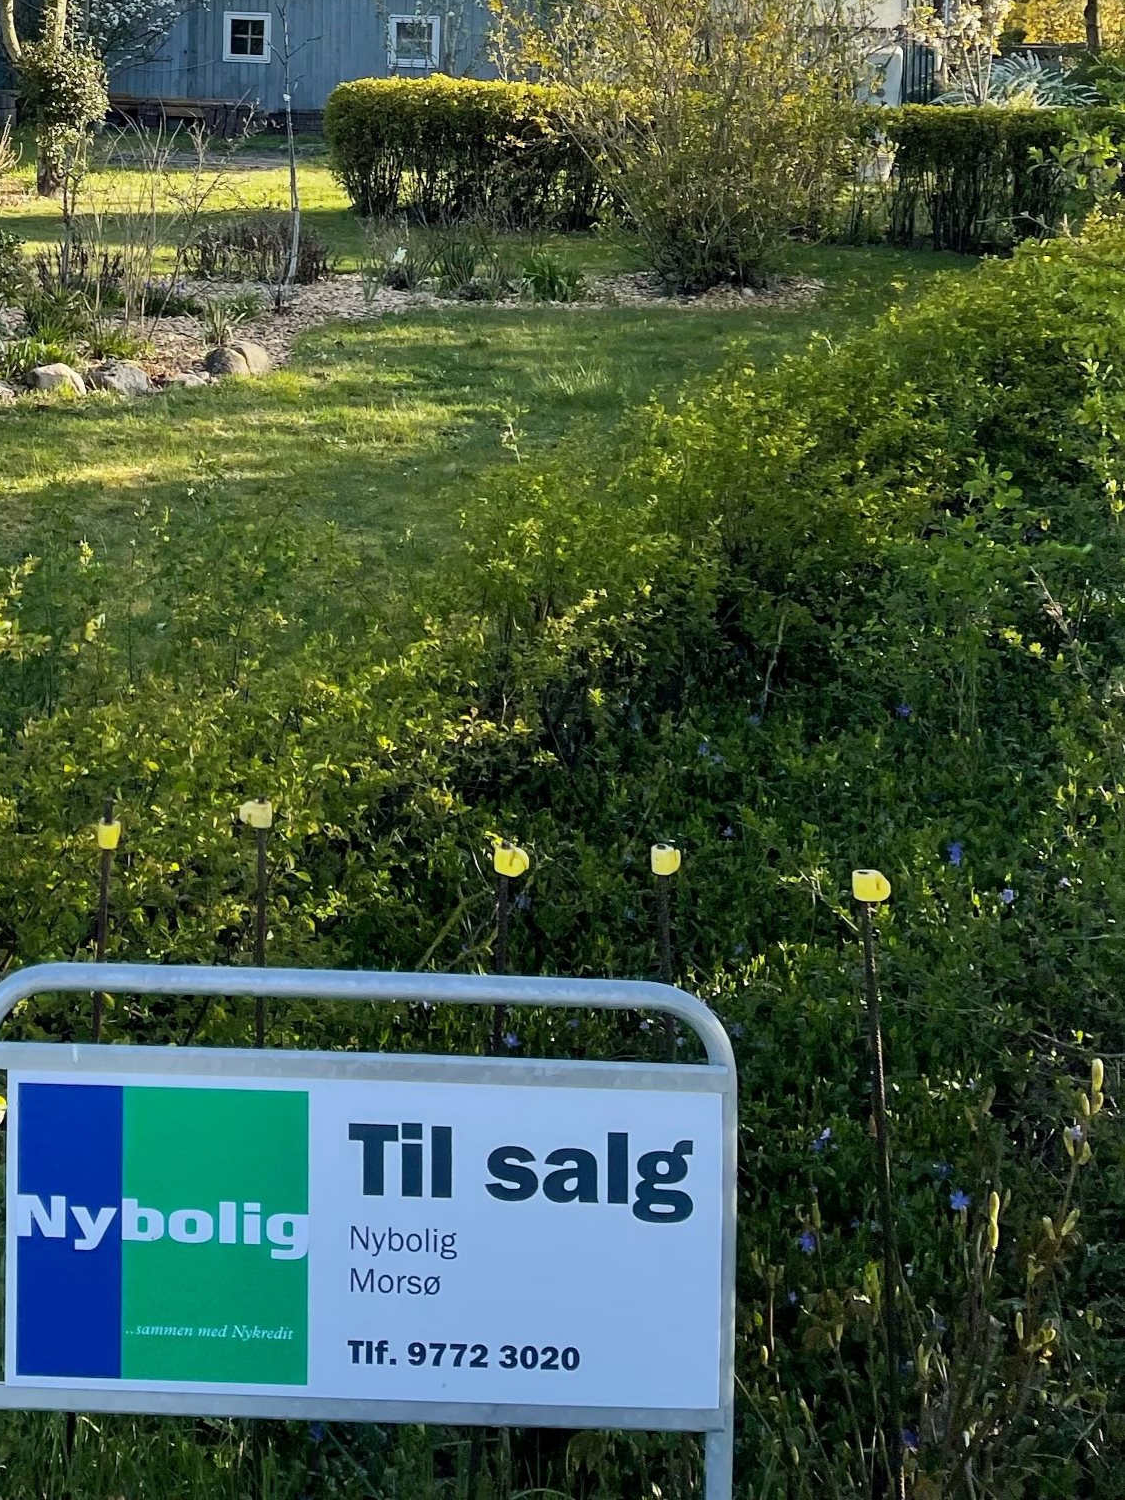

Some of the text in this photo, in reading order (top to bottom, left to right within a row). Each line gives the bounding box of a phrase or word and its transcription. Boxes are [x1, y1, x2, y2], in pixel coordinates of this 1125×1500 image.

[348, 1122, 694, 1224] Til salg
[16, 1194, 309, 1260] Nybolig
[349, 1225, 458, 1260] Nybolig
[349, 1267, 442, 1296] Morsø
[197, 1324, 228, 1338] med
[231, 1325, 293, 1342] Nykredit
[347, 1340, 581, 1372] Tlf. 9772 3020
